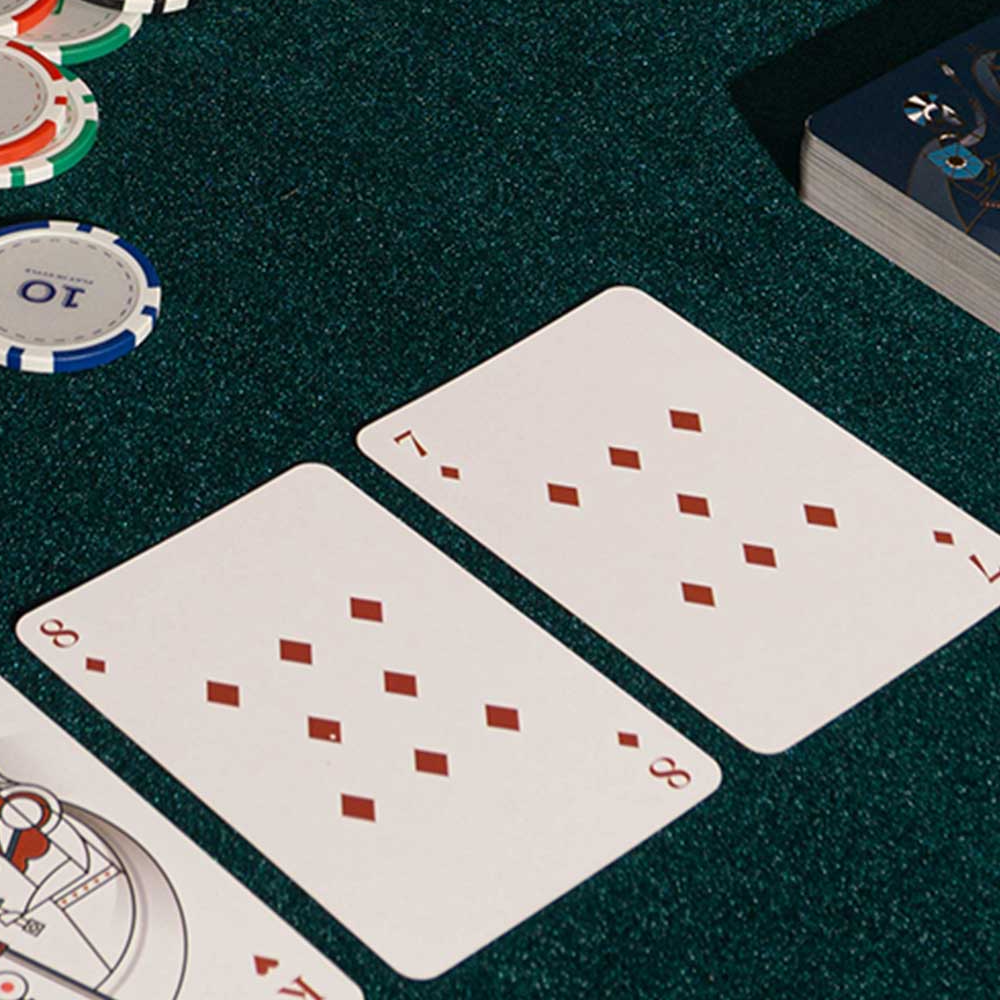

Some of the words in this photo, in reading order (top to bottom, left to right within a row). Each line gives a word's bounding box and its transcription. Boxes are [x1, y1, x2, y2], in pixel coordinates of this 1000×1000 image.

[17, 280, 86, 308] 10
[393, 429, 428, 457] 7
[968, 553, 1000, 584] 7
[40, 618, 80, 649] 8
[649, 756, 691, 789] 8
